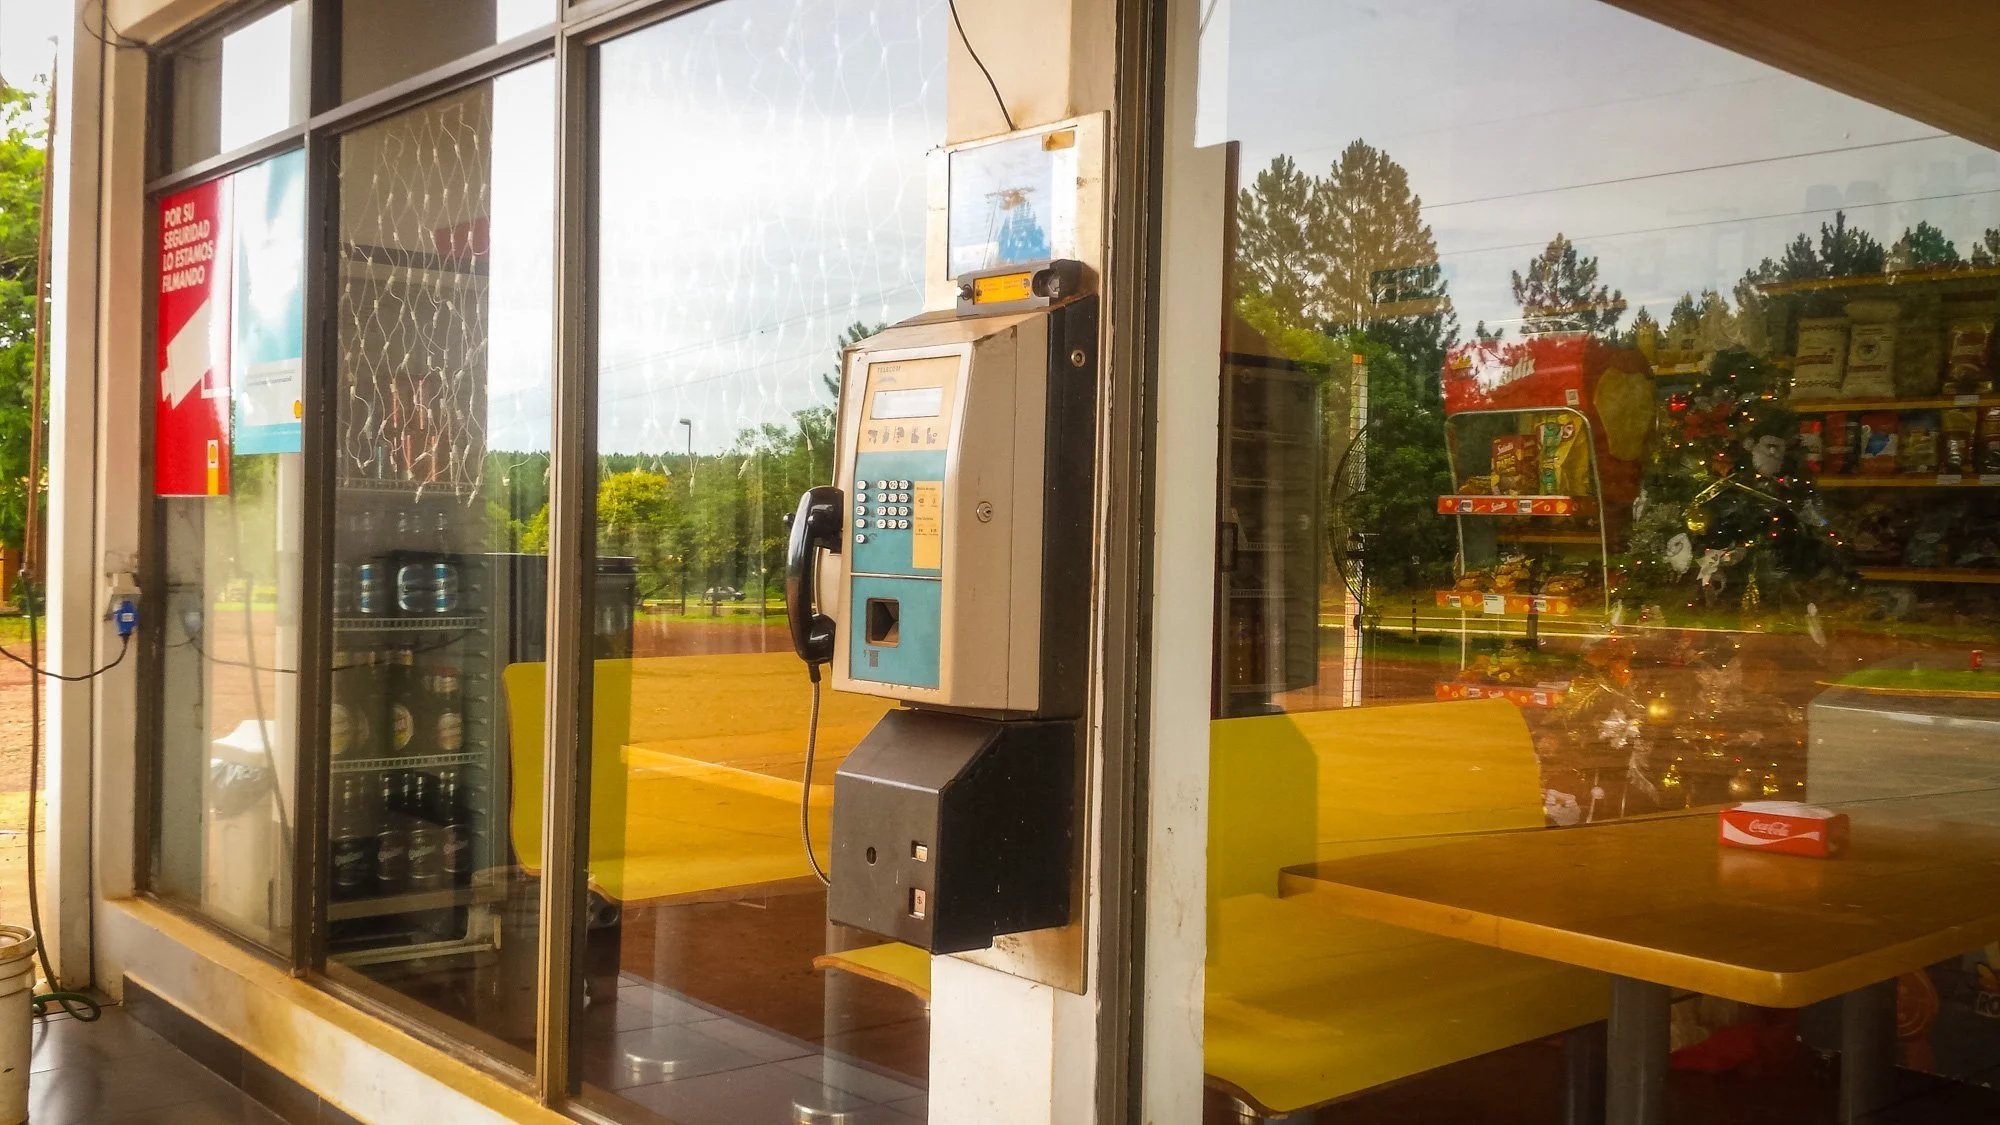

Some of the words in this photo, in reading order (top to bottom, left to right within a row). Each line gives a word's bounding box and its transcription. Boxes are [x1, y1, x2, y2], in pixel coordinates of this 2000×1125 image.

[164, 206, 181, 228] POR
[183, 202, 195, 222] SU
[164, 219, 210, 250] SEGURIDAD
[163, 252, 174, 272] LO
[175, 240, 213, 269] ESTAMOS
[162, 265, 205, 294] FILMANDO
